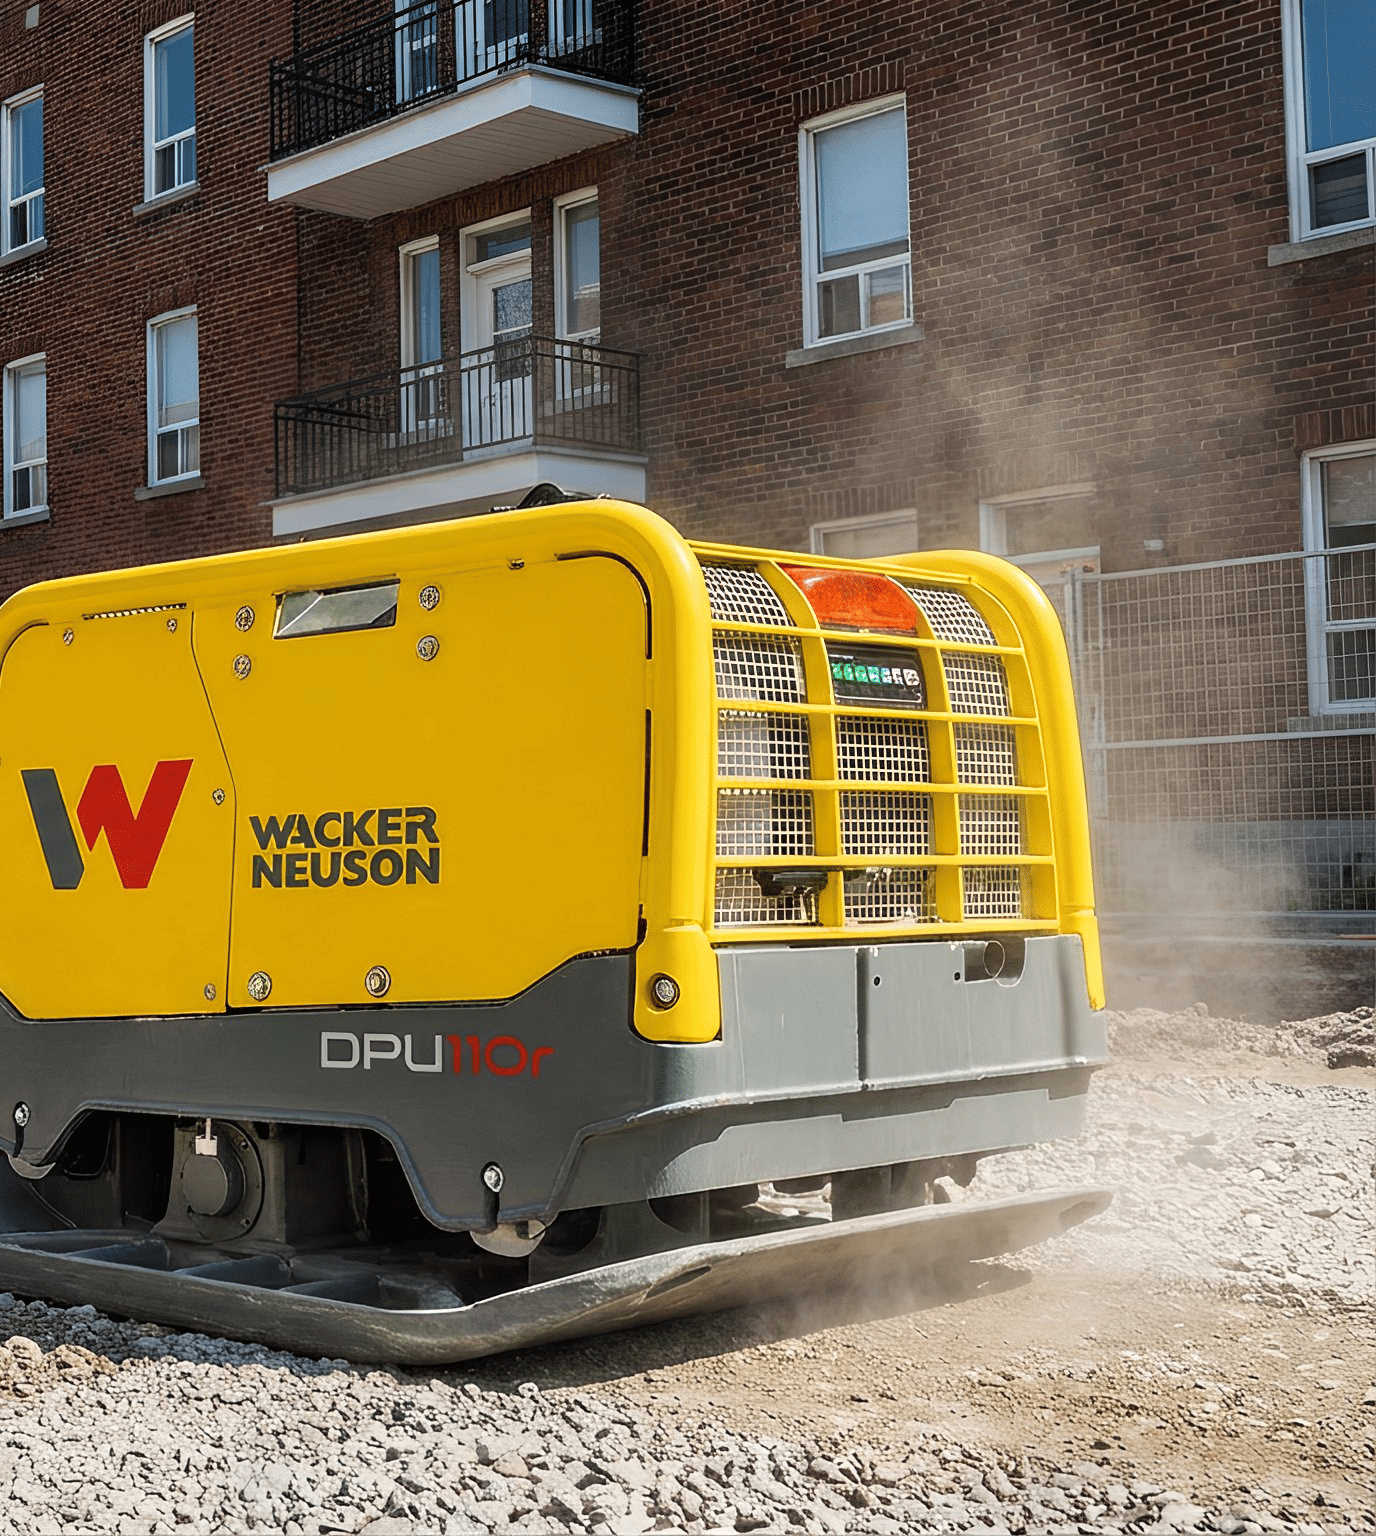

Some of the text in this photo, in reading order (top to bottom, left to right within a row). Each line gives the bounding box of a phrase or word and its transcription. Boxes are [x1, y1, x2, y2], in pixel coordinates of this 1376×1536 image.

[20, 759, 194, 889] W
[249, 806, 440, 851] WACKER
[251, 847, 440, 888] NEUSON
